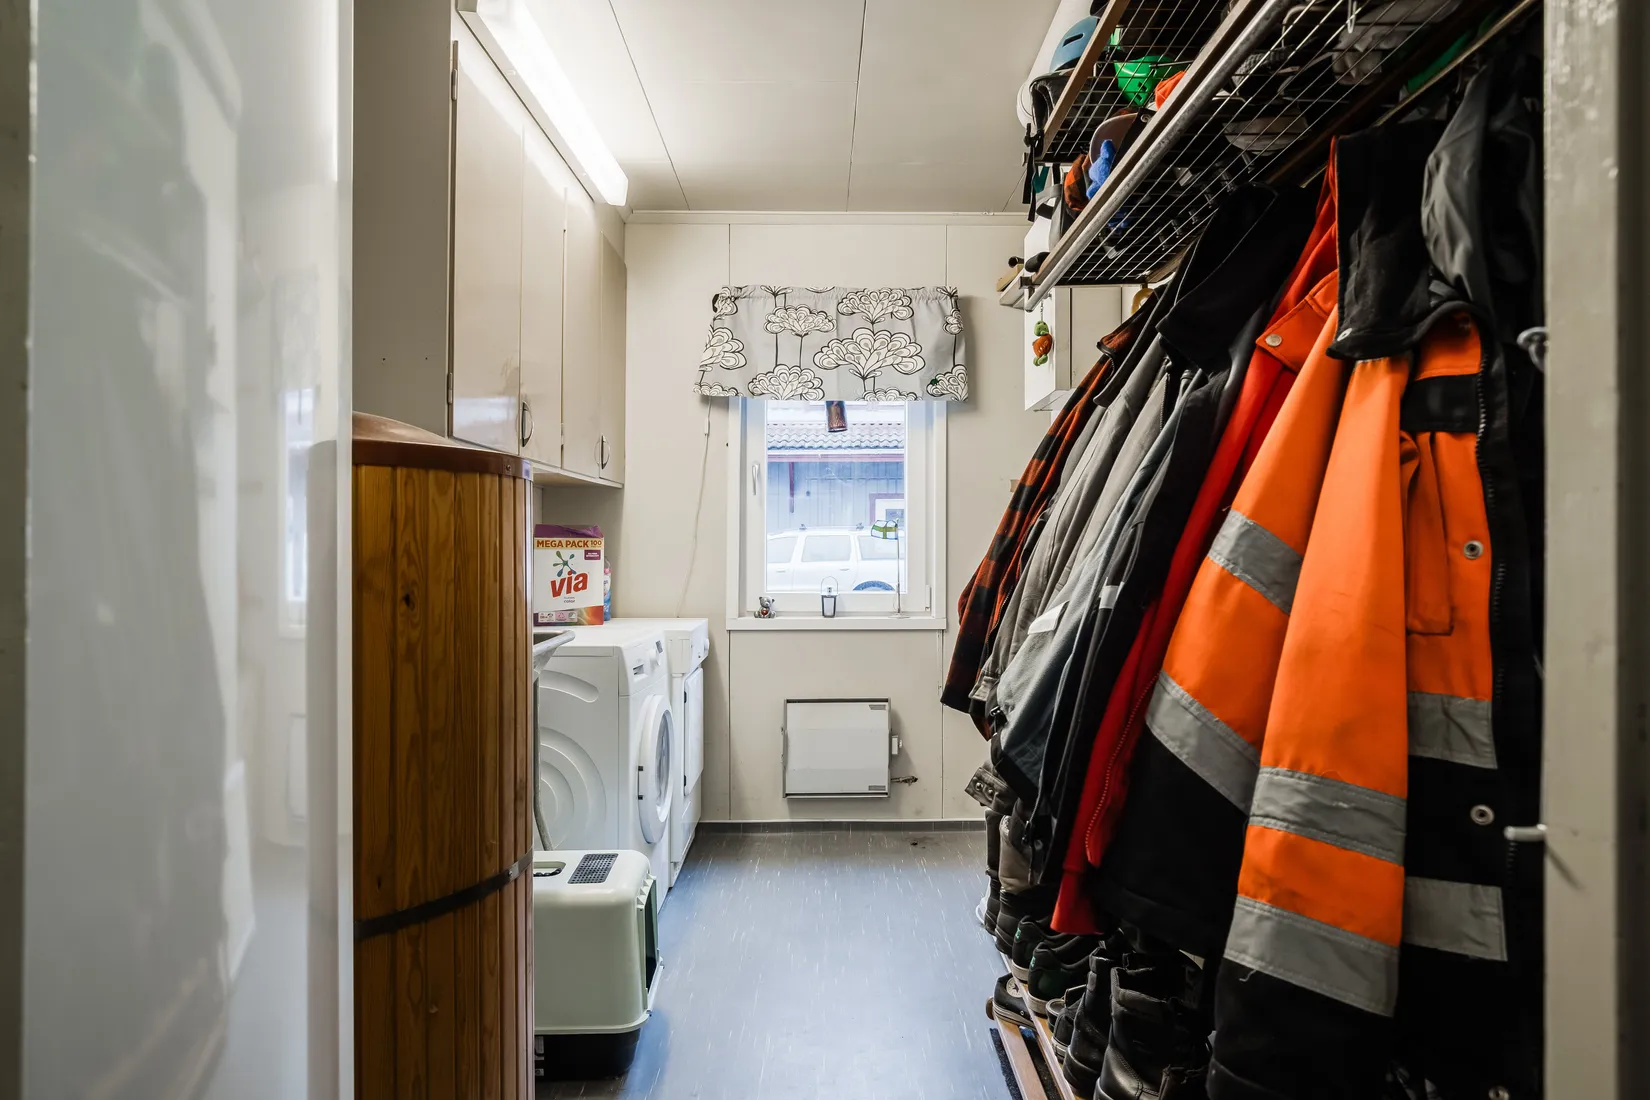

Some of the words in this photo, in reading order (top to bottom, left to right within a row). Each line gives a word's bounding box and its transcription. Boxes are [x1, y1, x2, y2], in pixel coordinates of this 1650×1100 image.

[536, 540, 564, 548] MEGA
[565, 540, 590, 548] PACK
[550, 570, 588, 598] via
